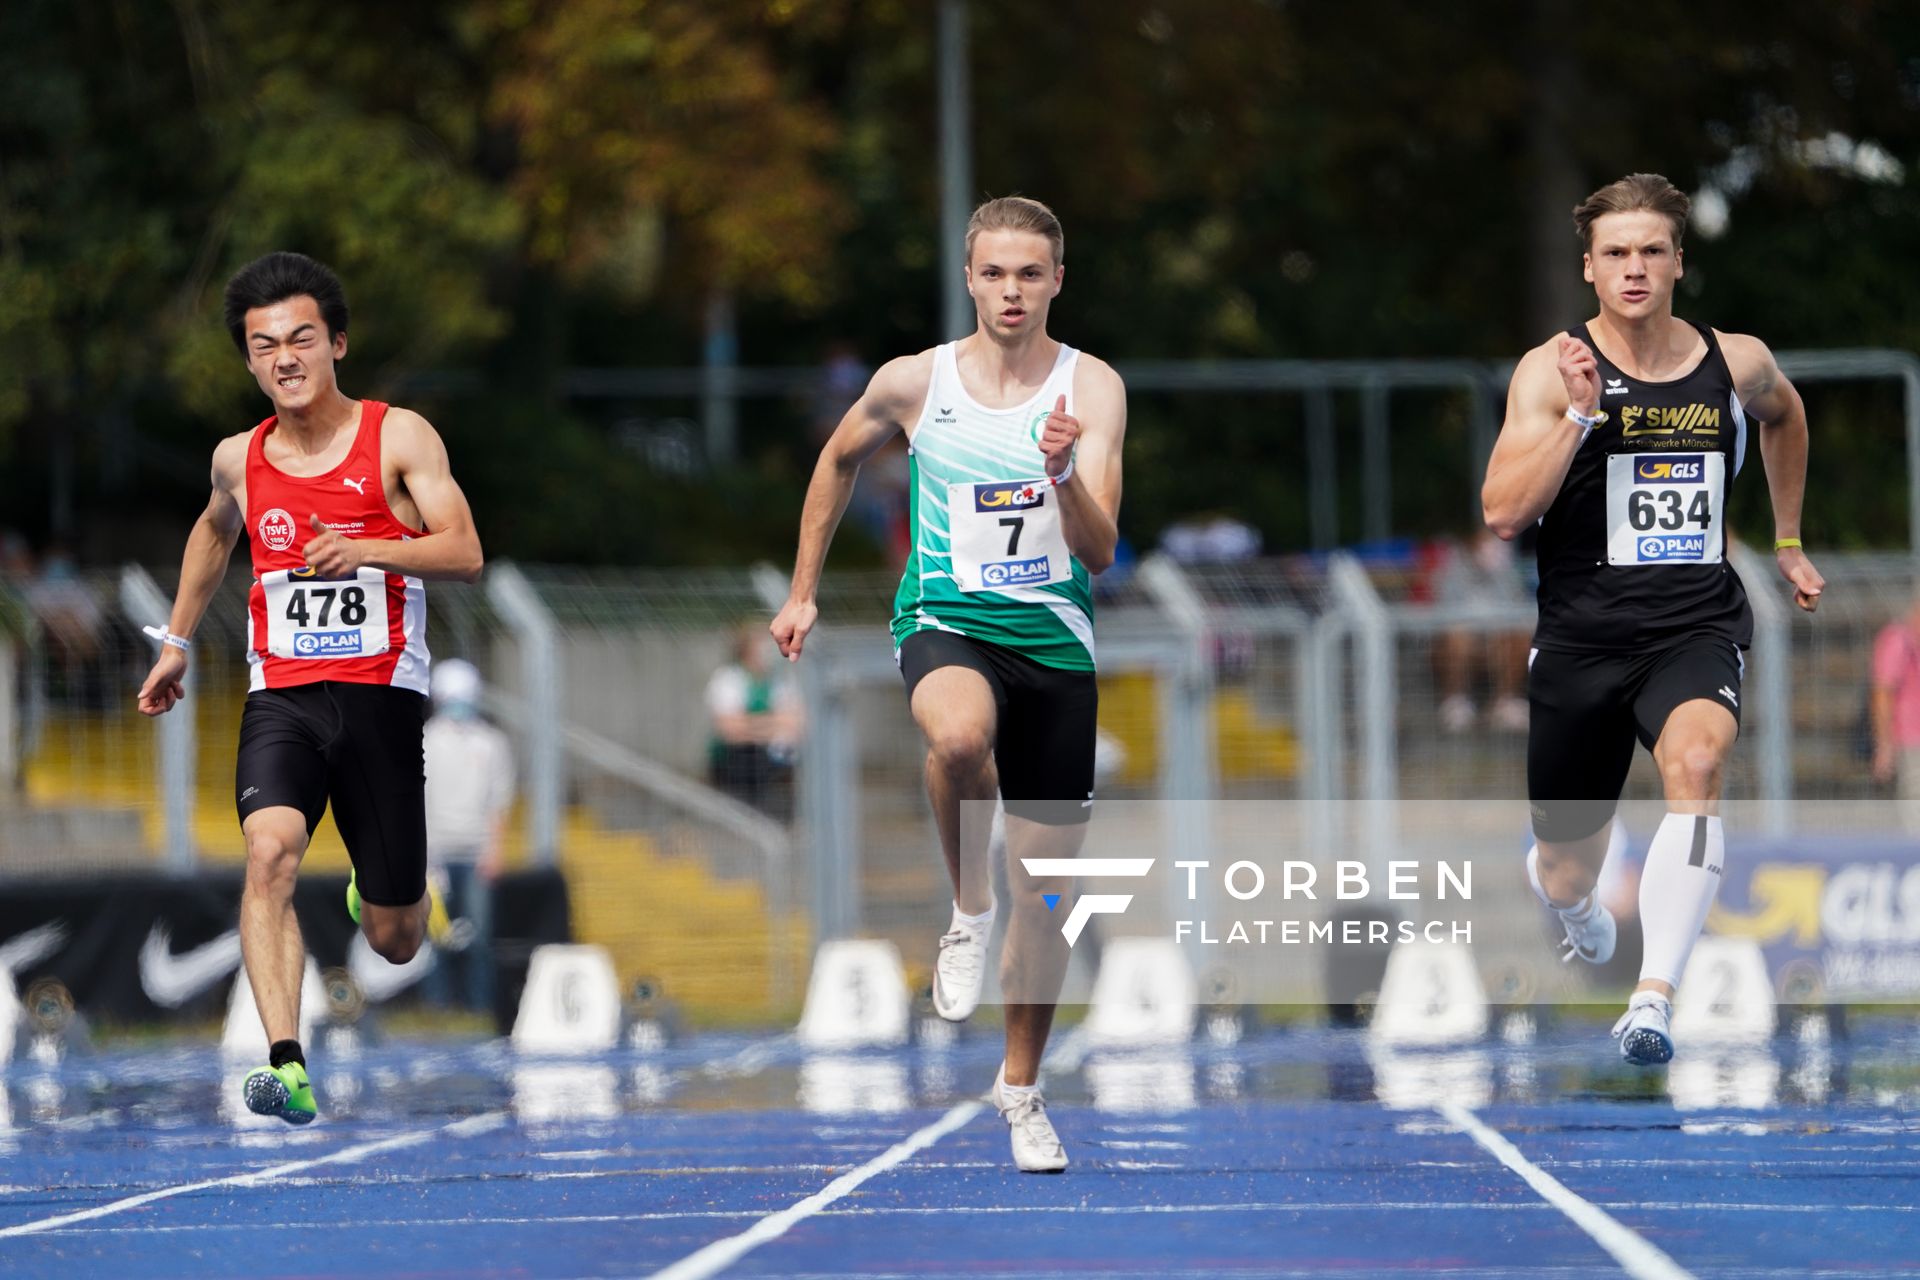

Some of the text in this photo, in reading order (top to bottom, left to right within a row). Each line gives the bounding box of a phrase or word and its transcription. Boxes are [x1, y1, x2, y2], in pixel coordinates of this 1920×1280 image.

[1671, 462, 1699, 478] GLS
[1628, 490, 1711, 531] 634
[265, 525, 288, 536] TSVE
[998, 516, 1024, 556] 7
[1667, 539, 1703, 551] PLAN
[1010, 561, 1048, 577] PLAN
[286, 586, 367, 627] 478
[320, 634, 360, 648] PLAN
